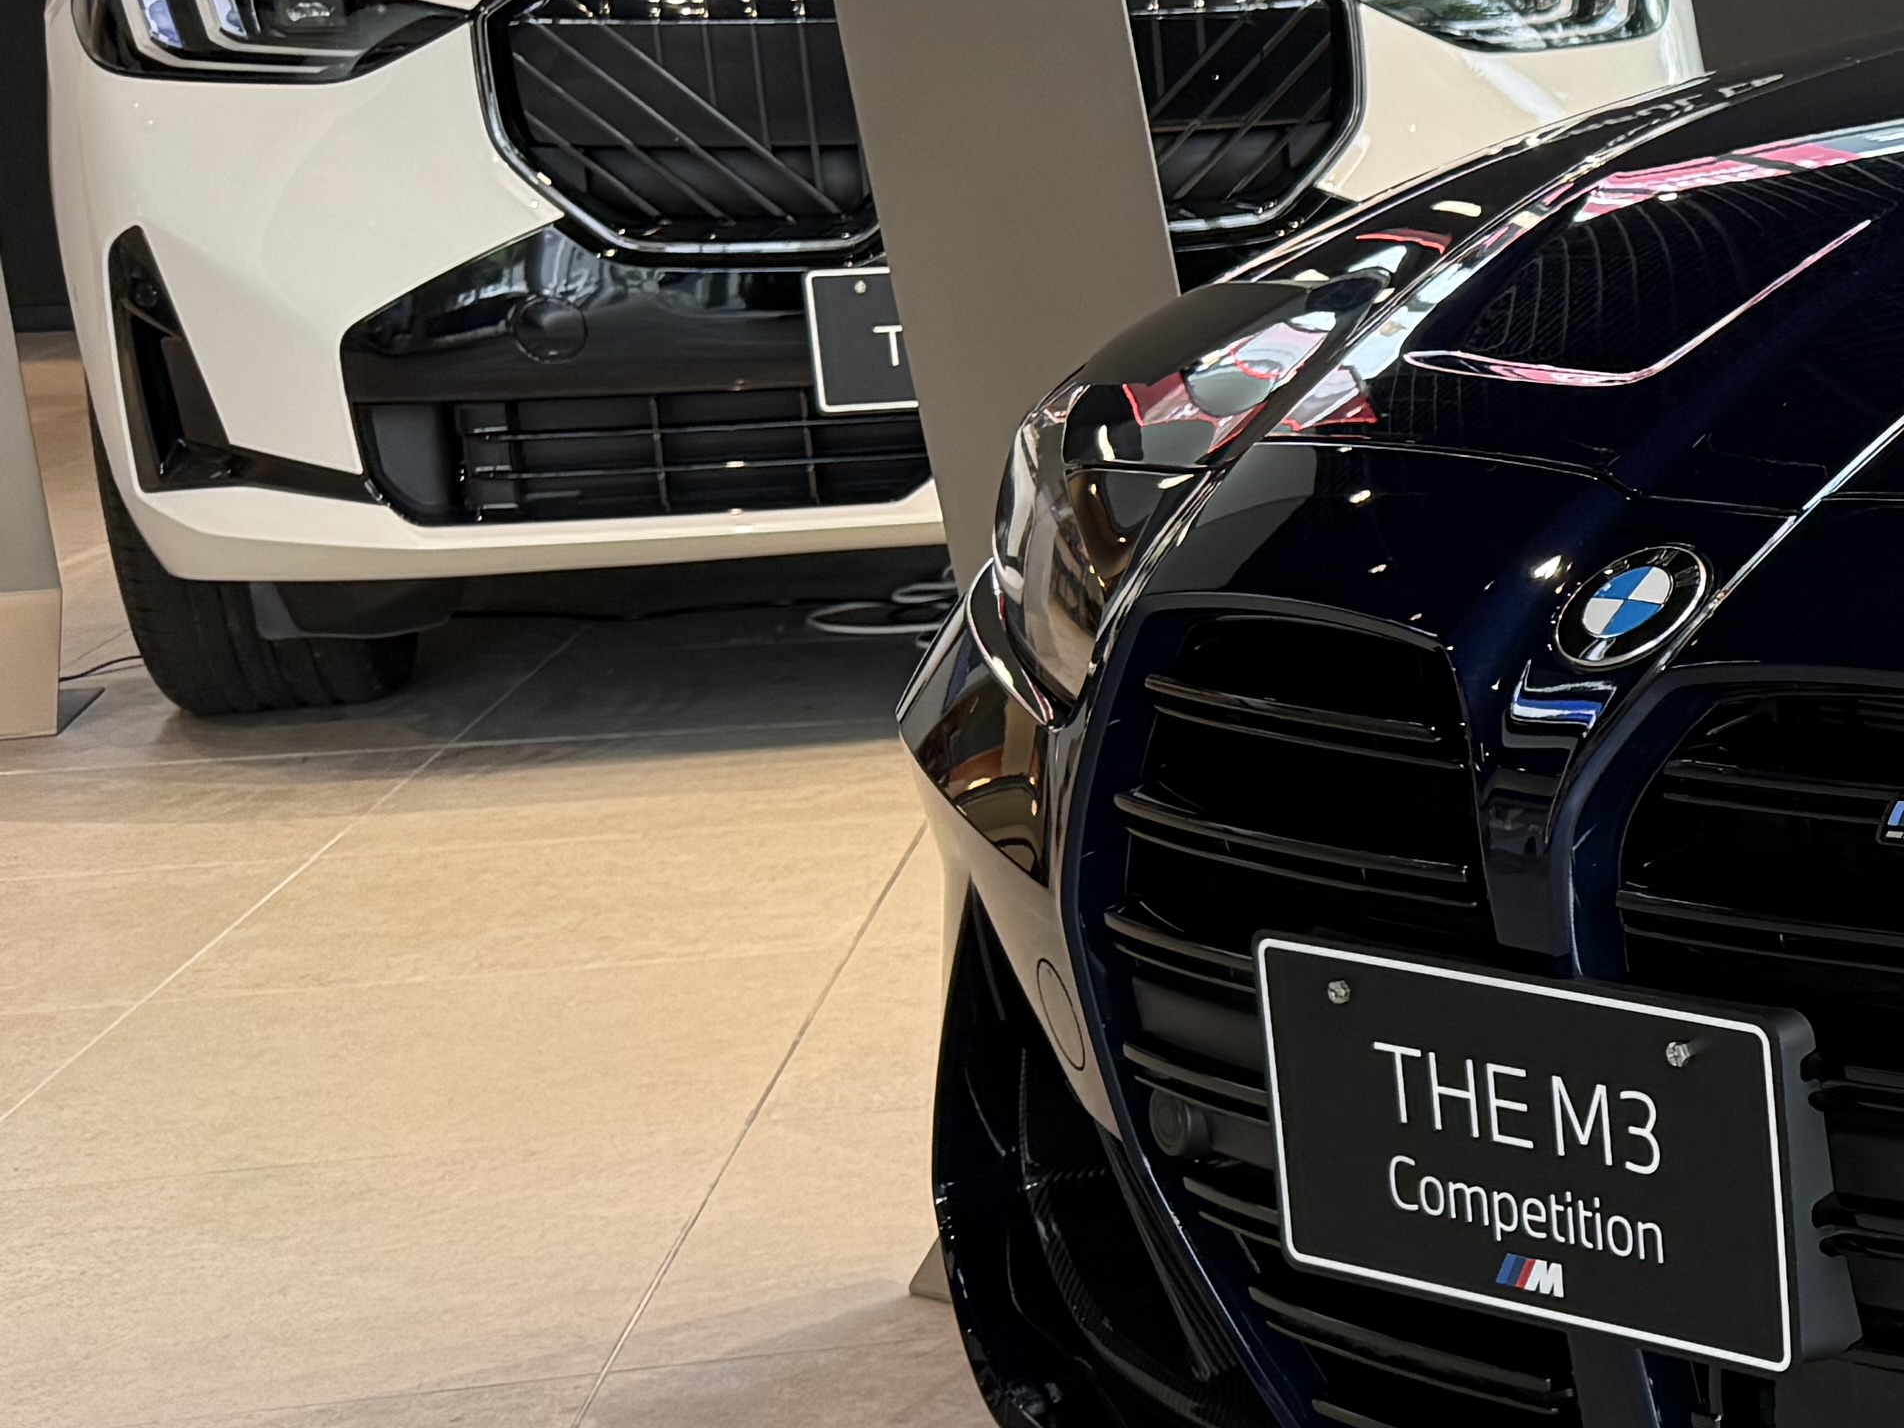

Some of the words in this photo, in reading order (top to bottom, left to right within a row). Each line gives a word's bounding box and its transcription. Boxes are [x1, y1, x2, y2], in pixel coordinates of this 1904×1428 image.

[1373, 1041, 1534, 1149] THE
[1551, 1075, 1661, 1175] M3
[1389, 1155, 1664, 1264] Competition
